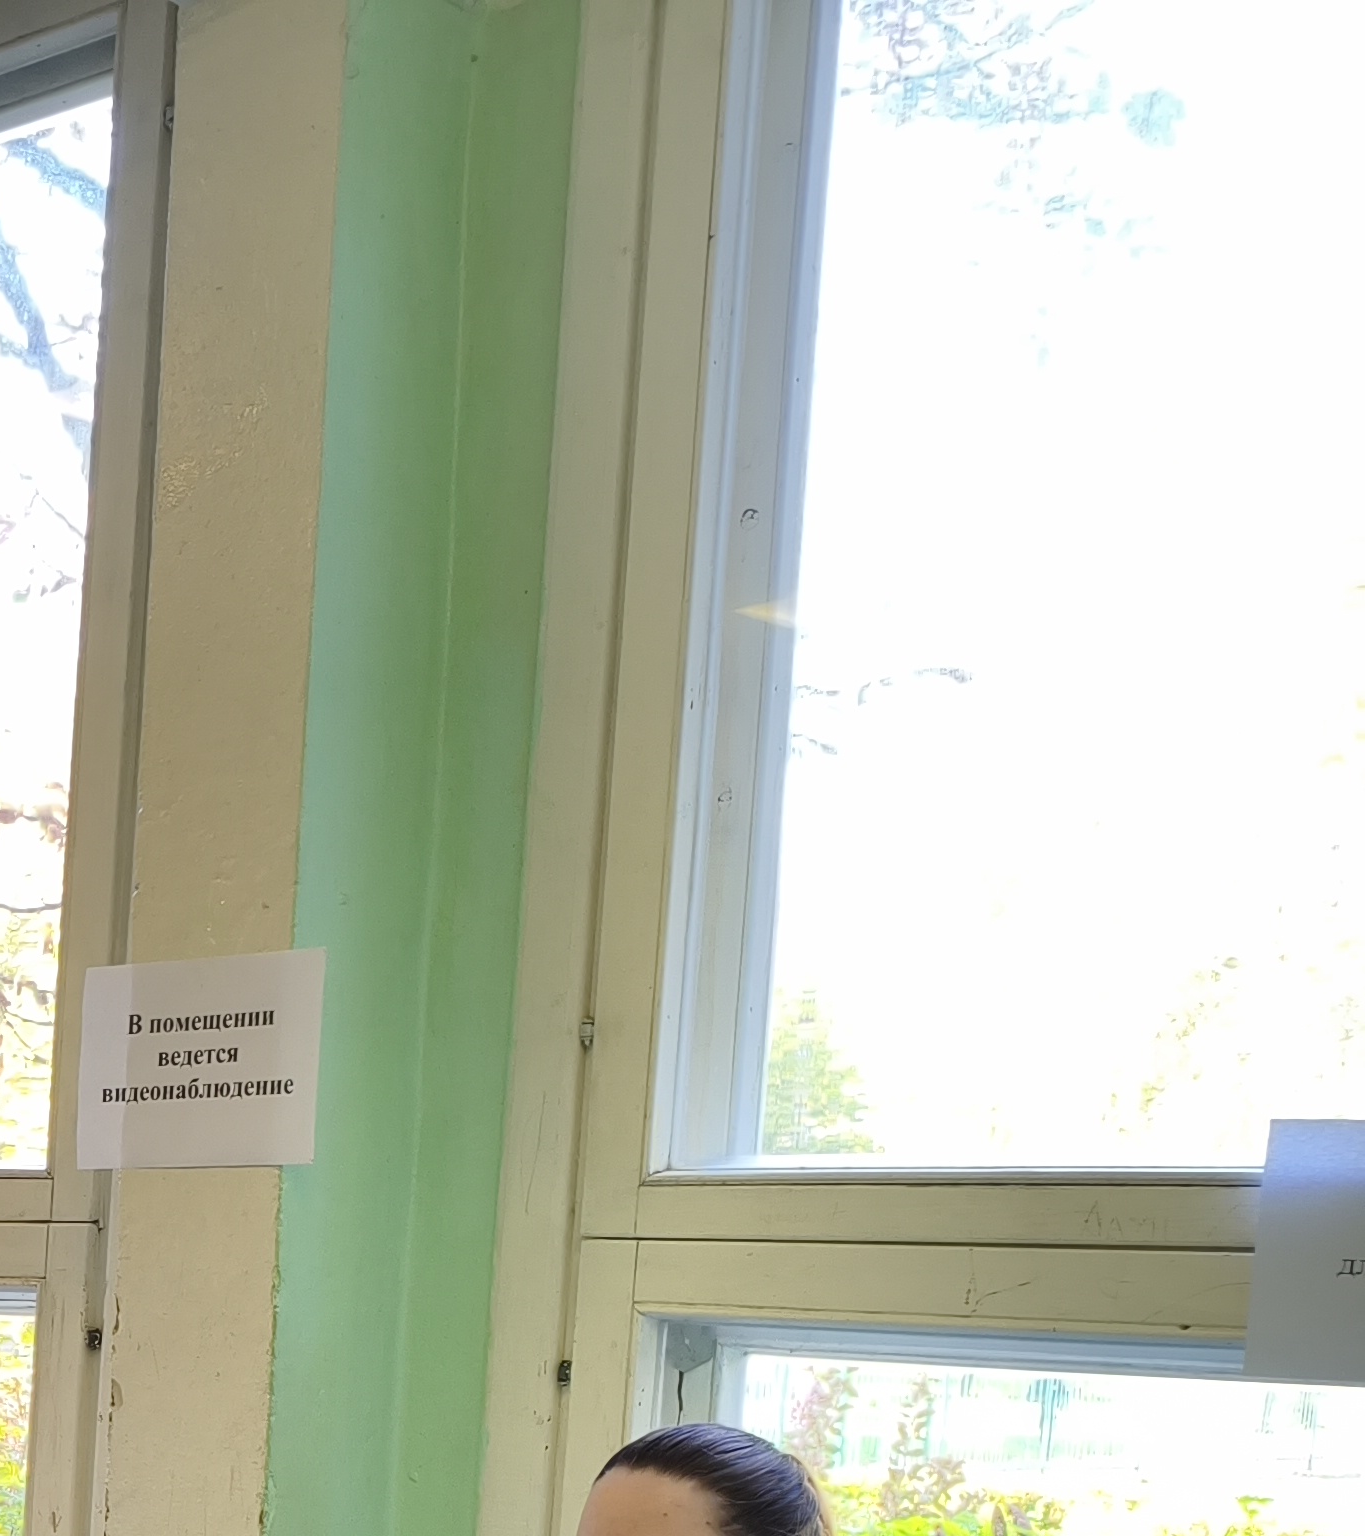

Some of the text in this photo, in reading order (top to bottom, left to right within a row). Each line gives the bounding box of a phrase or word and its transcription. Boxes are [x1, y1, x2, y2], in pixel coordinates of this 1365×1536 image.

[126, 1010, 275, 1035] В помещении
[157, 1047, 239, 1069] ведется
[102, 1077, 294, 1105] видеонаблюдение
